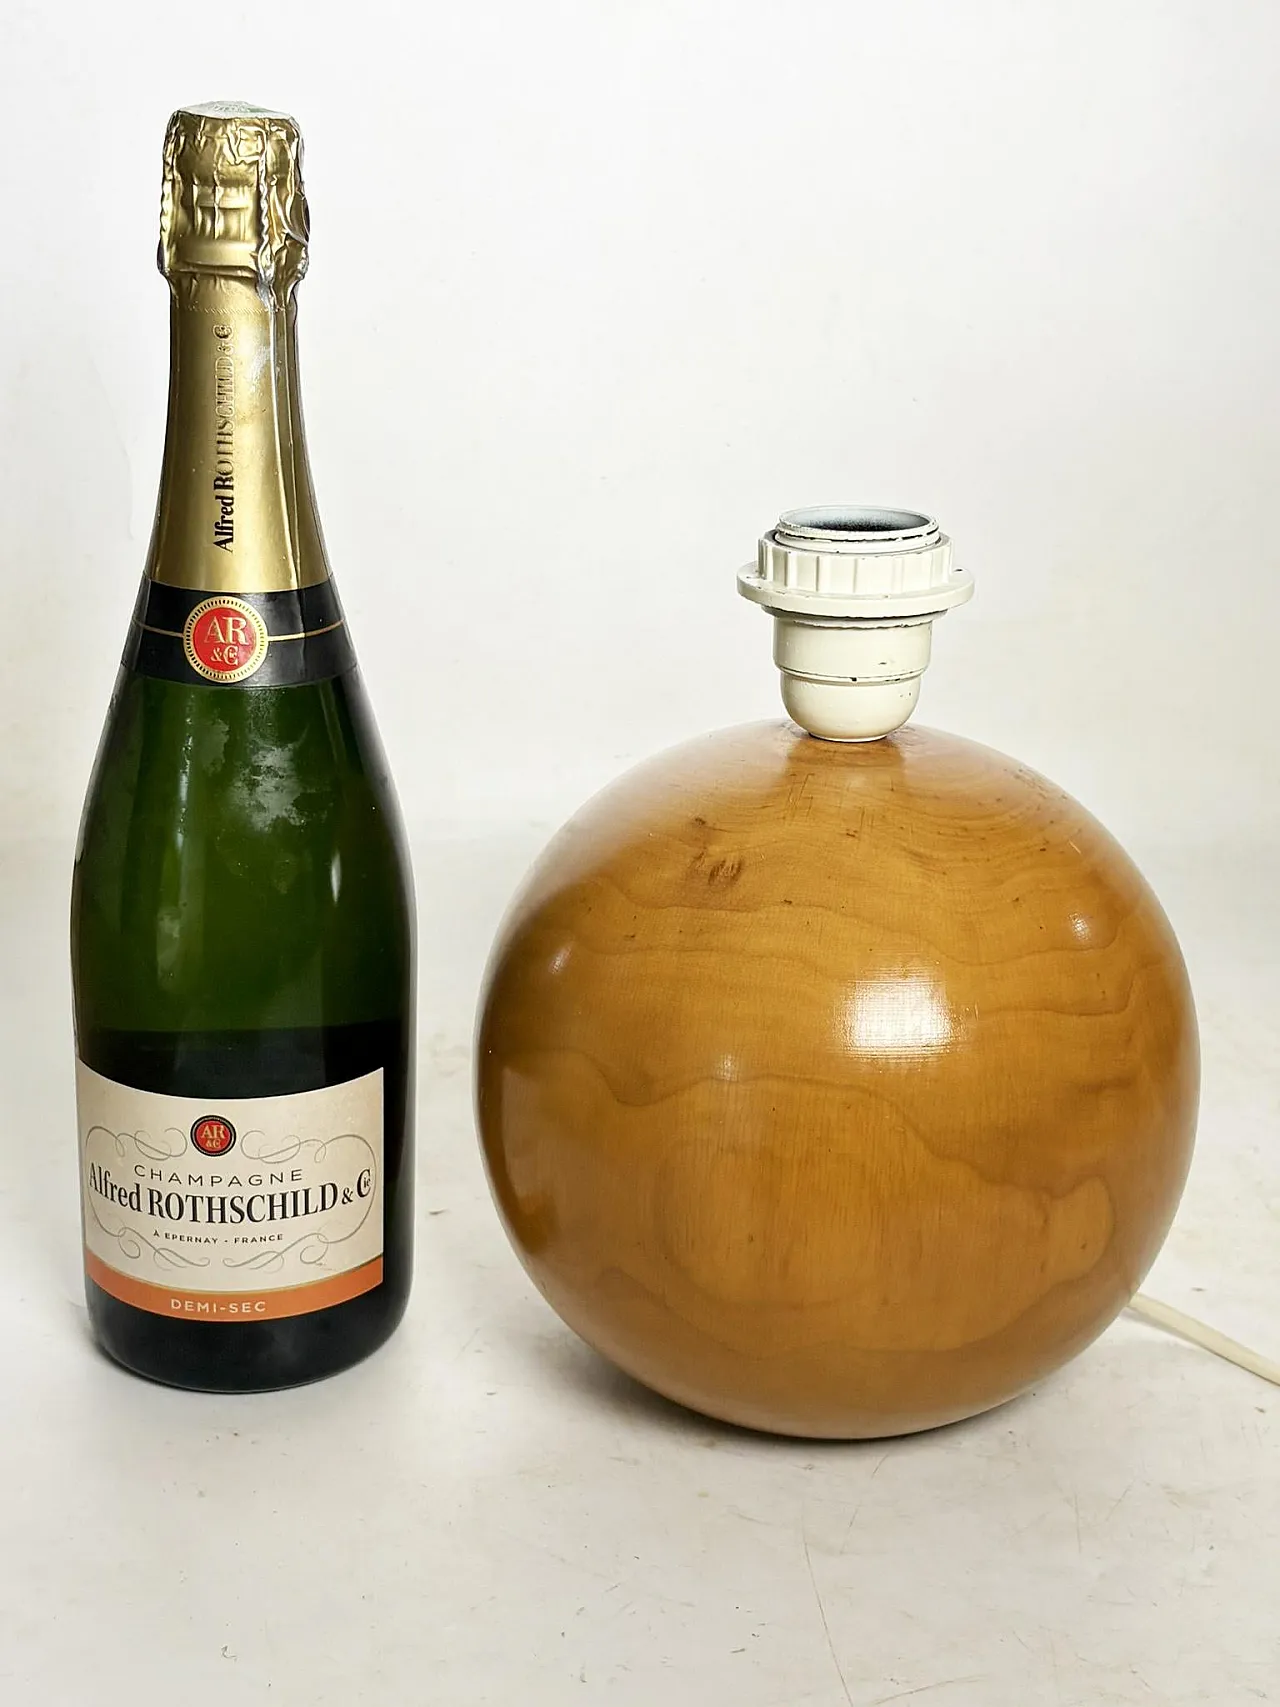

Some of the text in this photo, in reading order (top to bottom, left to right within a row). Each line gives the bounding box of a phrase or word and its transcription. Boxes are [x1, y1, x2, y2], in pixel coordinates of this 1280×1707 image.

[212, 495, 234, 553] Alfred
[203, 616, 250, 646] AR
[200, 1124, 226, 1139] AR
[134, 1164, 303, 1188] CHAMPAGNE
[89, 1162, 141, 1213] Alfred
[147, 1182, 338, 1224] ROTHSCHILD
[341, 1187, 354, 1205] &
[164, 1232, 219, 1245] EPERNAY
[233, 1233, 284, 1245] FRANCE
[170, 1298, 267, 1314] DEMI-SEC
